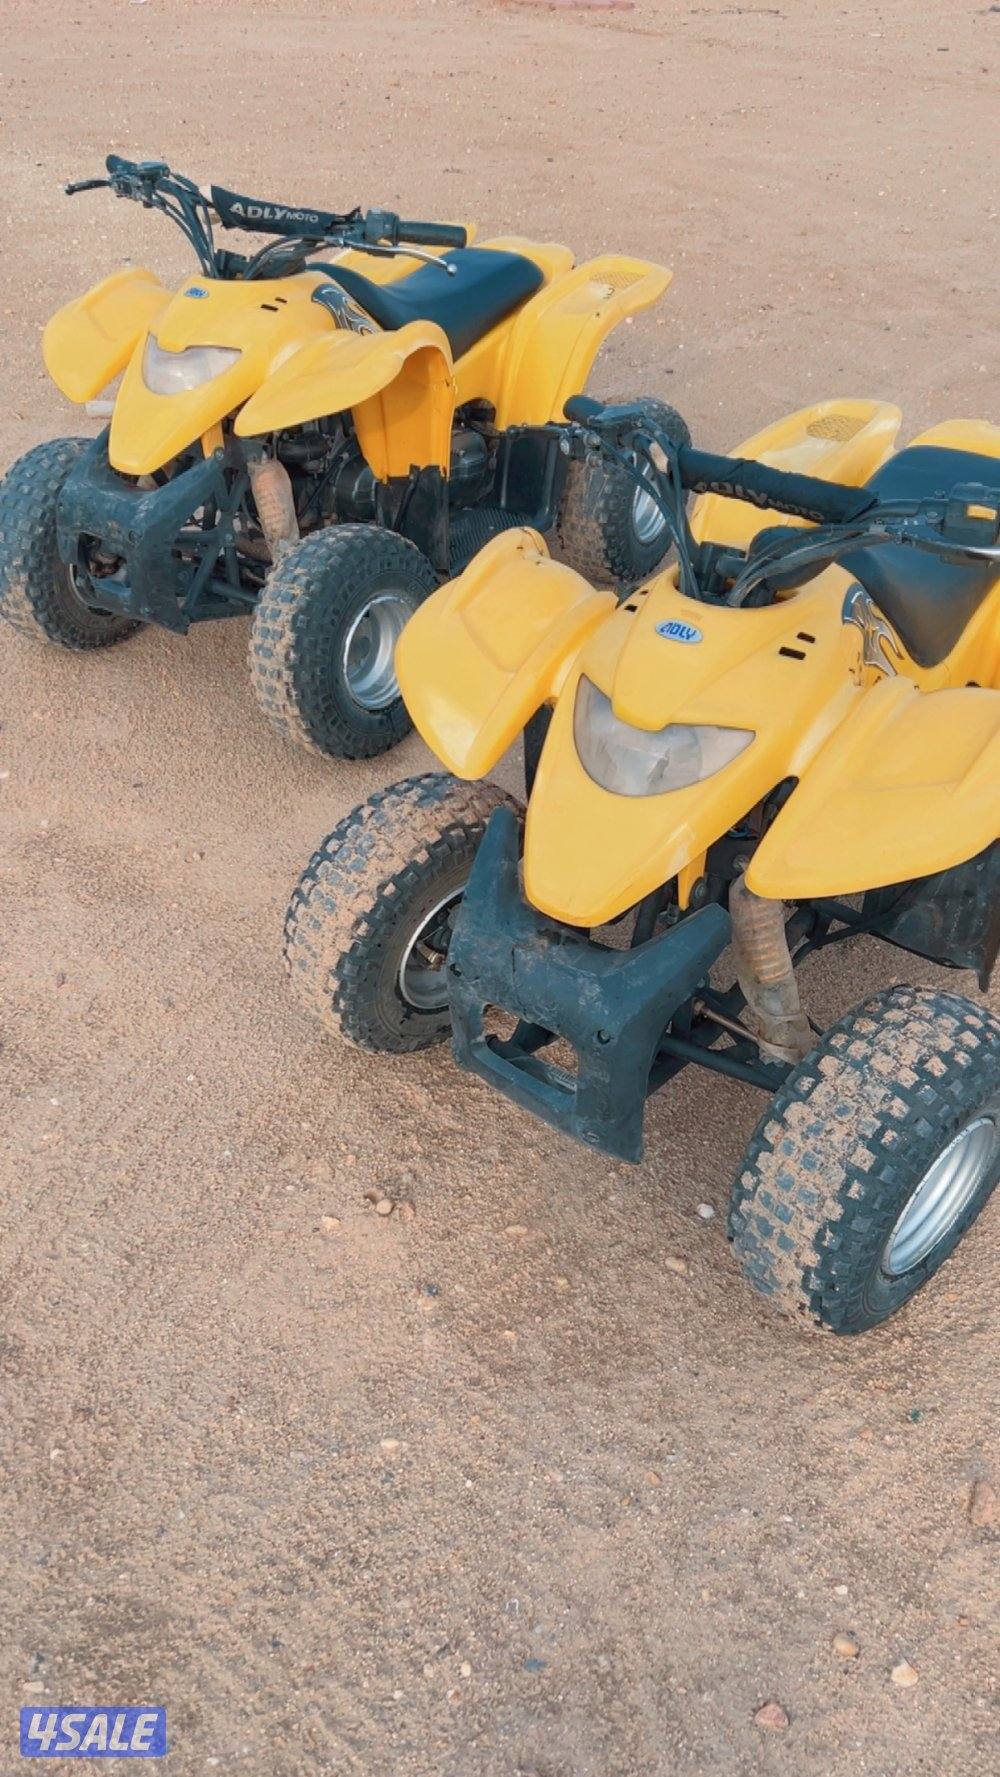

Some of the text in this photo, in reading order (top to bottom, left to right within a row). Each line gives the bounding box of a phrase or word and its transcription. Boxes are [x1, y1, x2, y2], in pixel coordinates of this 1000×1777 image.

[229, 201, 319, 222] ADLY MOTO
[660, 622, 697, 640] ADLY
